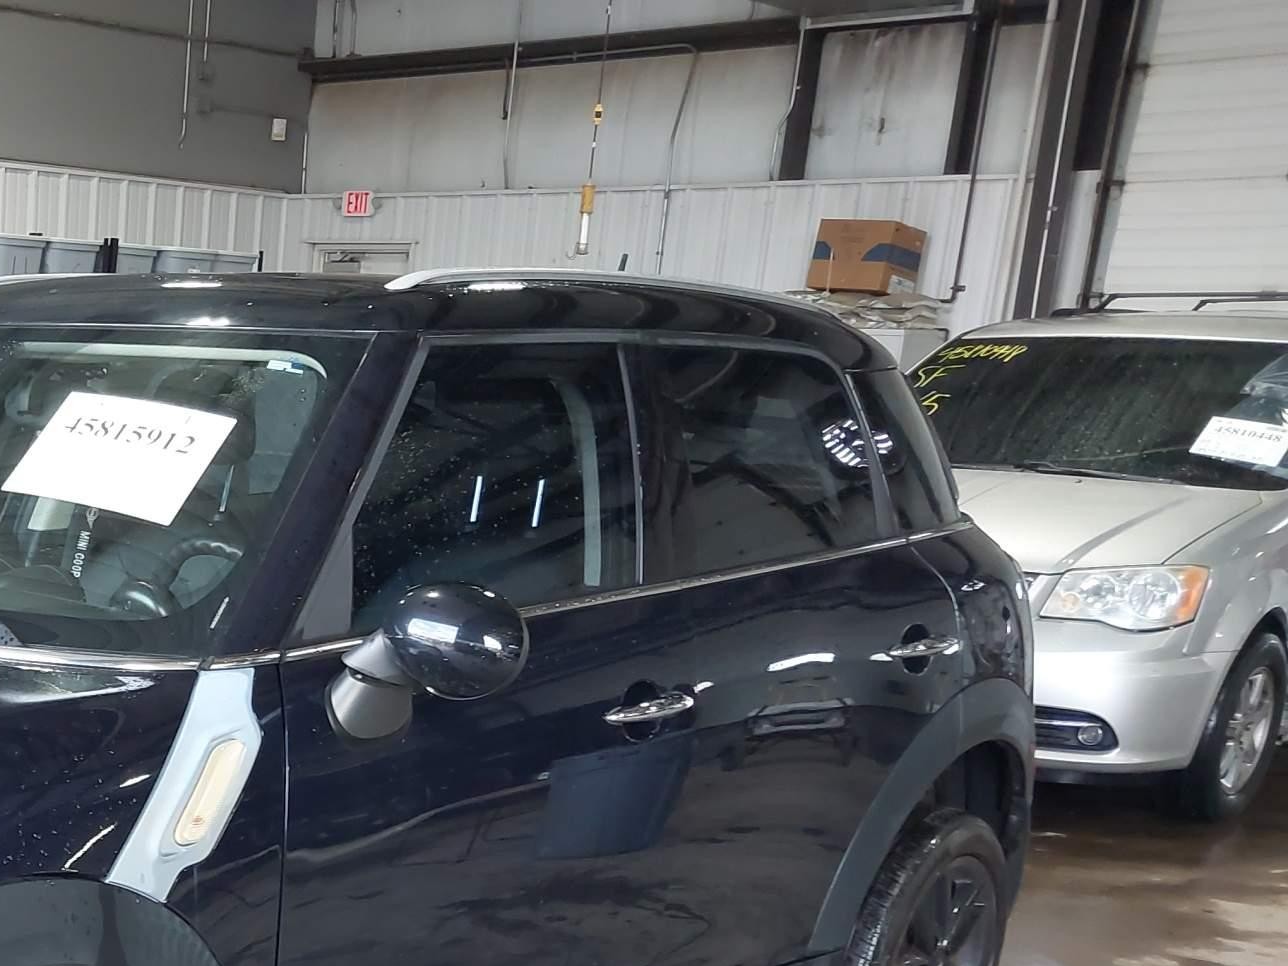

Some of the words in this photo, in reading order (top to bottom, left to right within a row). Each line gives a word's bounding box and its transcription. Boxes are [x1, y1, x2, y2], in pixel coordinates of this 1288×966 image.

[347, 192, 370, 213] EXIT
[64, 417, 196, 455] 45815912
[76, 530, 91, 551] MINI
